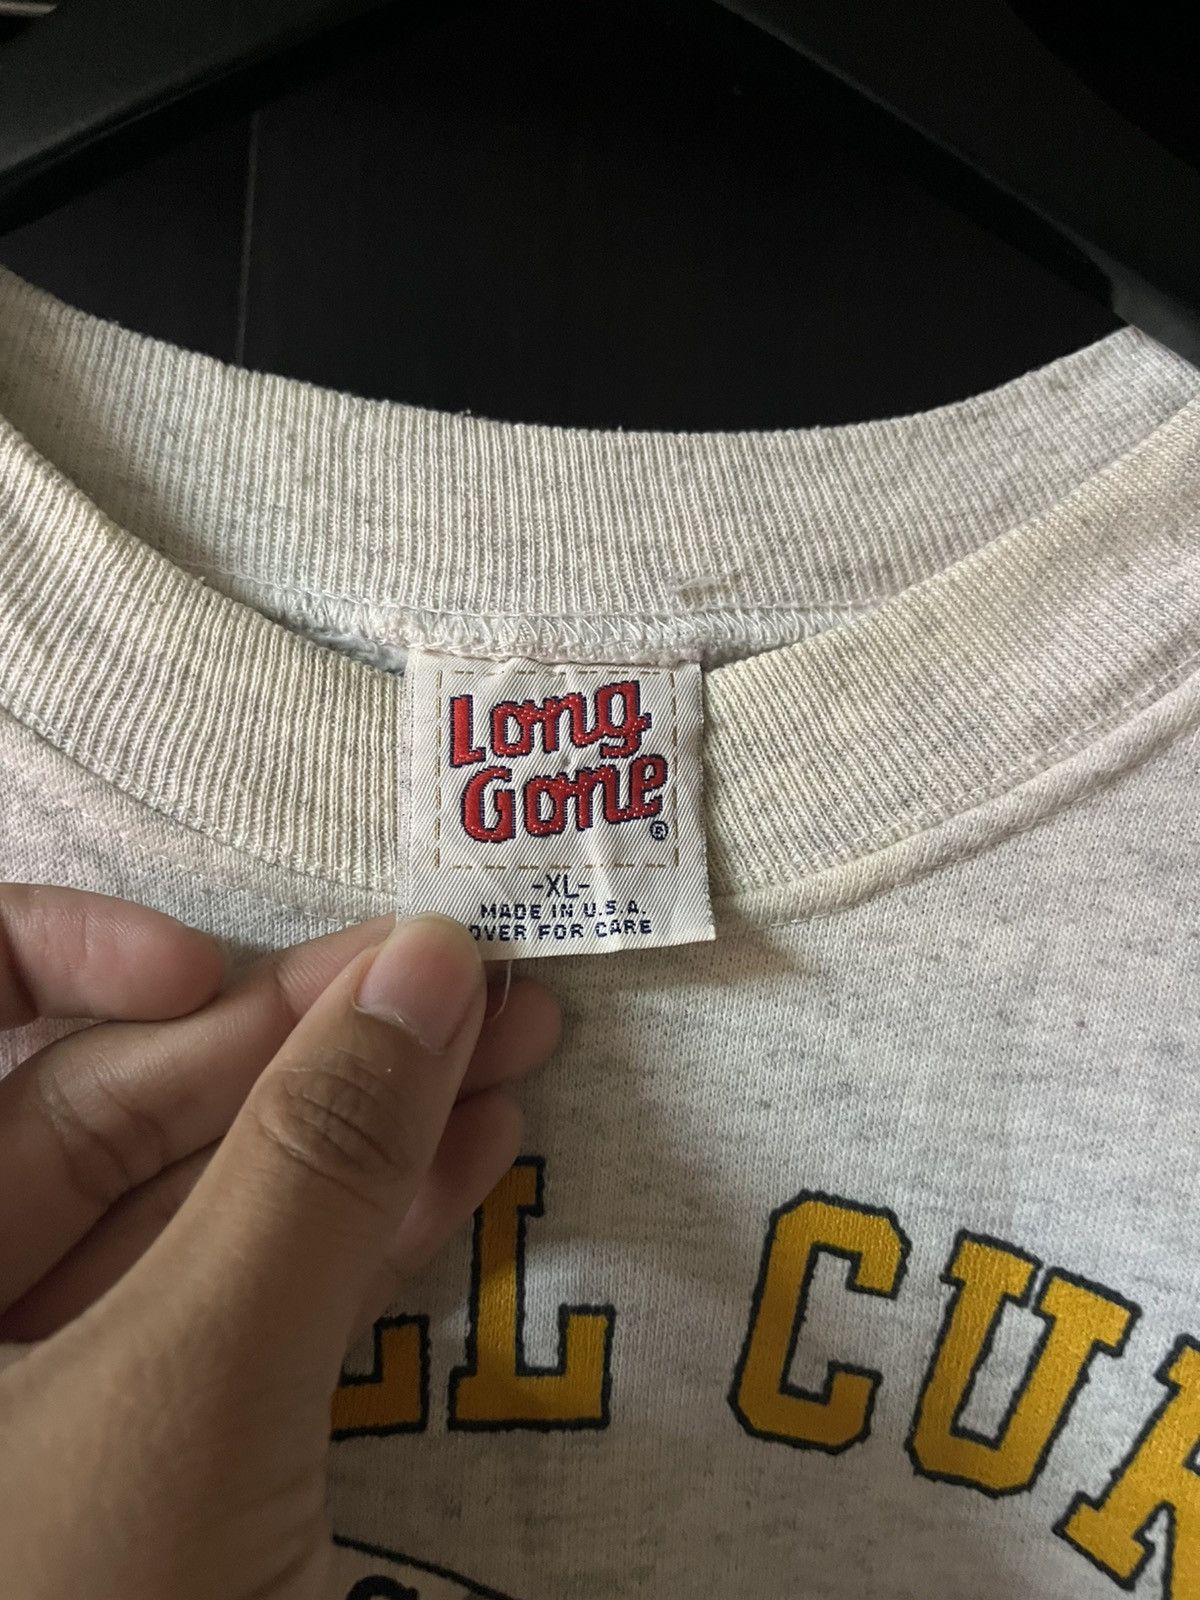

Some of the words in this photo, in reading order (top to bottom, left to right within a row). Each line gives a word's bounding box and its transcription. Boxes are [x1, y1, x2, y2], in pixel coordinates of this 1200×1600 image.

[449, 680, 652, 768] Long
[461, 754, 668, 843] Gone
[480, 903, 542, 920] MADE
[551, 903, 574, 918] IN
[583, 900, 647, 918] U.S.A.
[538, 923, 584, 940] FOR
[595, 919, 652, 938] CARE
